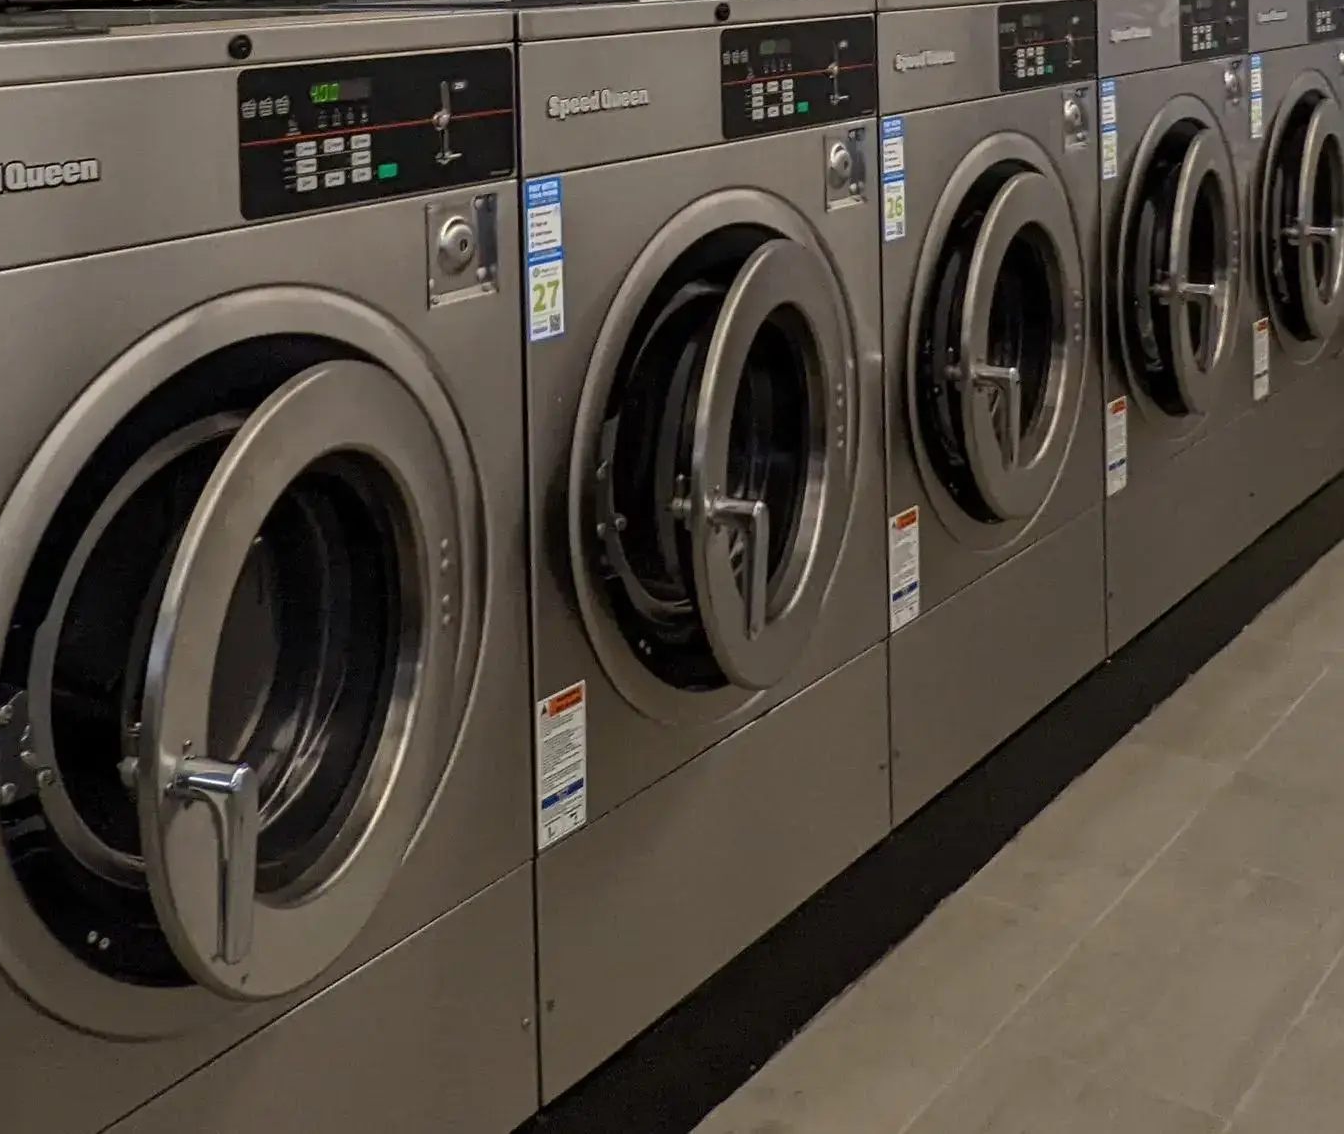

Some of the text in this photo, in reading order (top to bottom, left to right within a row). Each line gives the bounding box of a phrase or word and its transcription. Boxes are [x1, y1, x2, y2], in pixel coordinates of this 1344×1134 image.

[547, 89, 600, 121] Speed
[4, 158, 100, 192] Queen
[533, 279, 559, 312] 27
